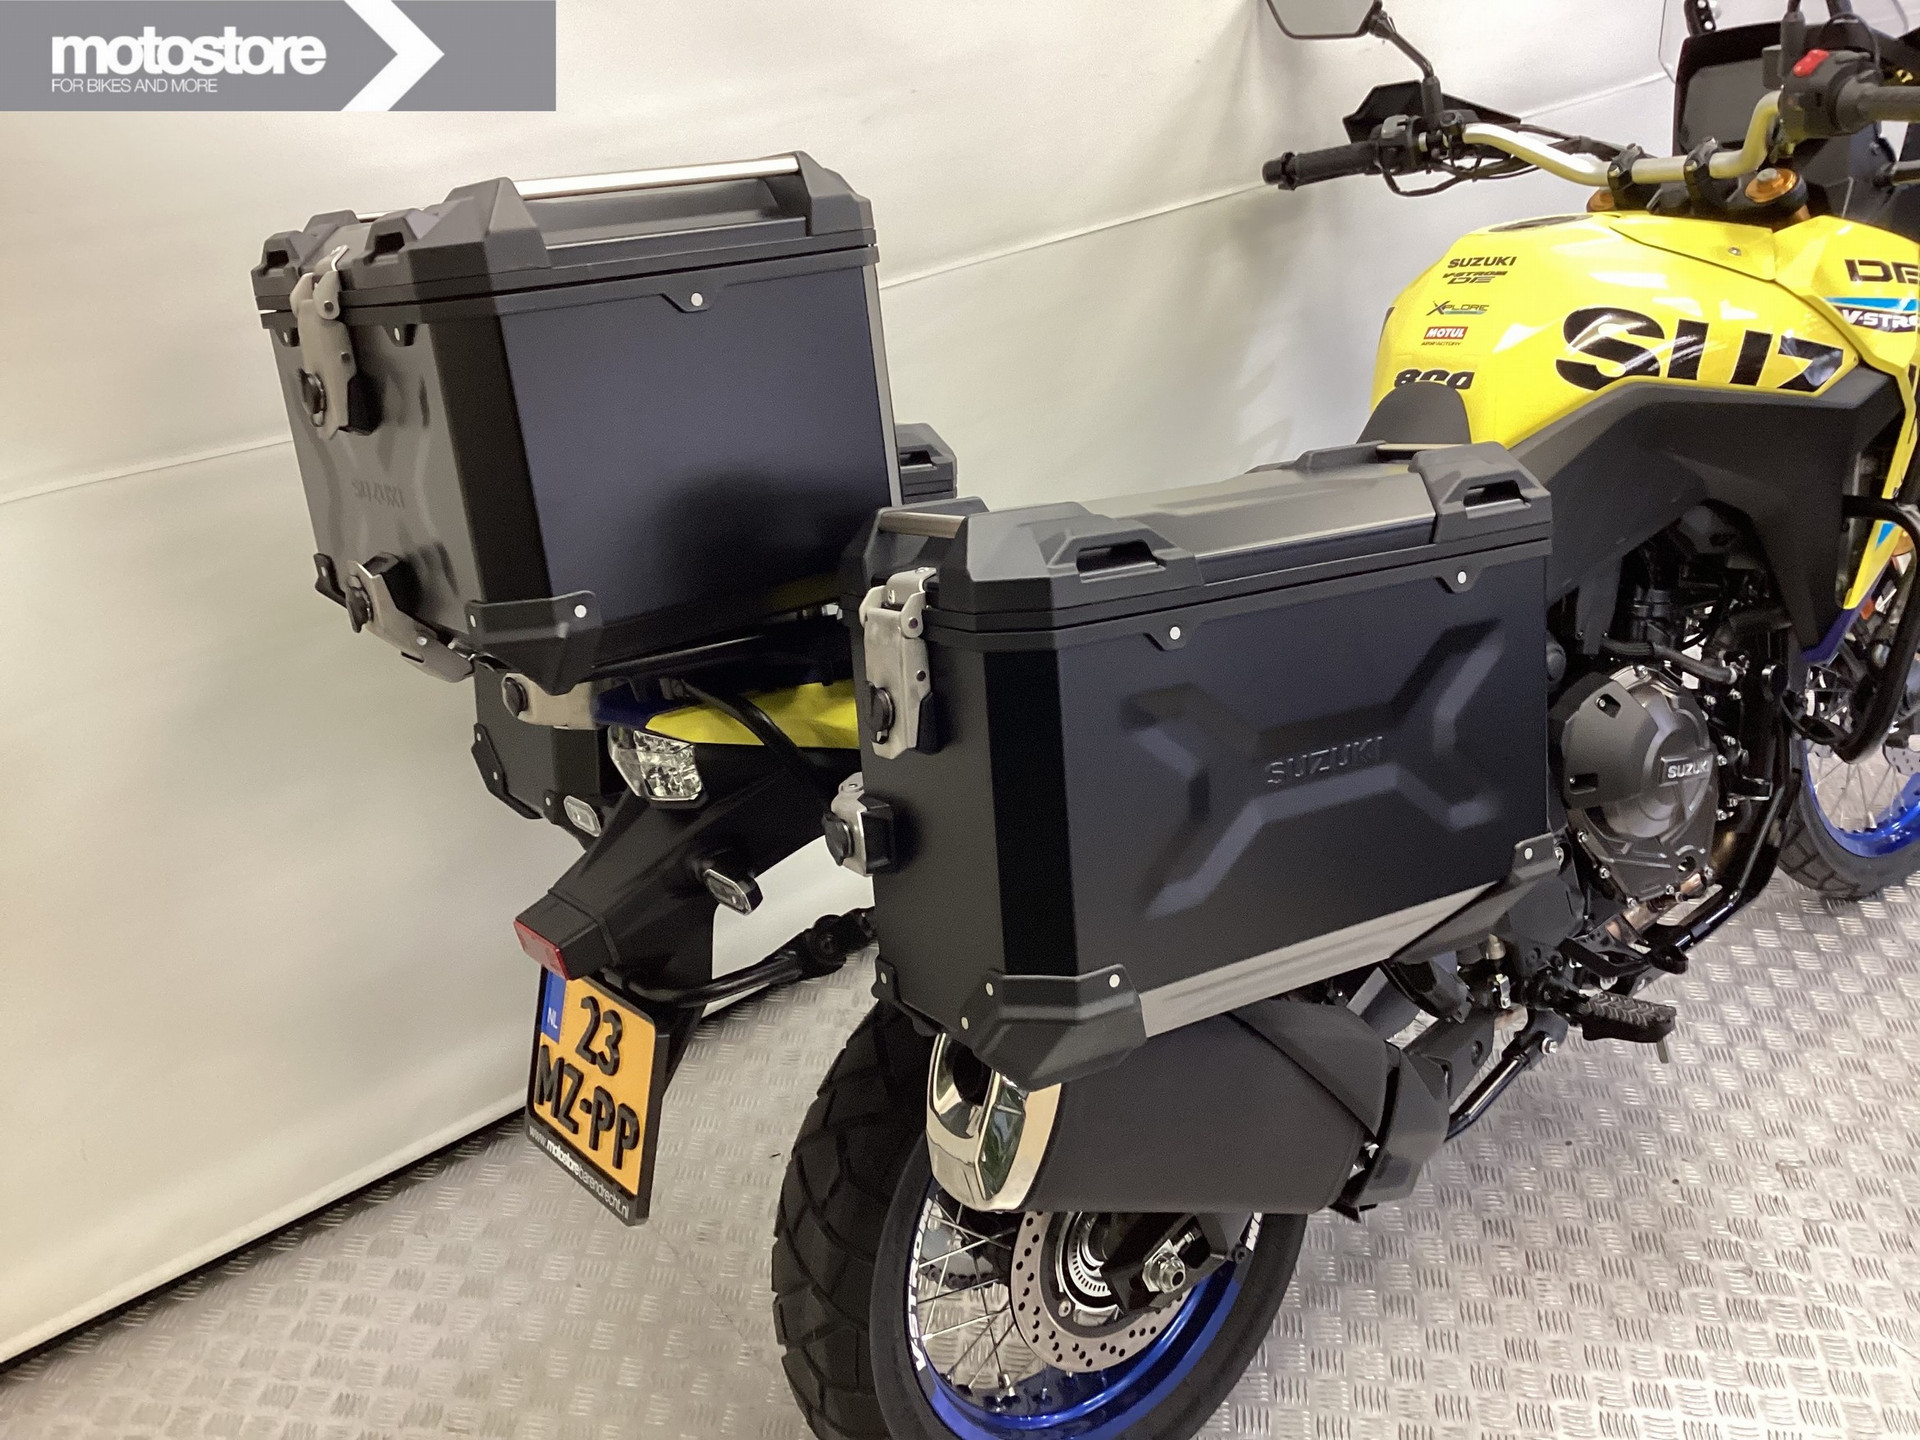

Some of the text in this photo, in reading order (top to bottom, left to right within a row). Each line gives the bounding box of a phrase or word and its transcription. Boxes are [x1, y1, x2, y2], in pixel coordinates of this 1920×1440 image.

[1447, 256, 1517, 268] SUZUKI
[1426, 328, 1465, 338] MOTUL
[1264, 736, 1383, 784] SUZUKI
[547, 1007, 558, 1029] NL
[575, 995, 623, 1077] 23
[534, 1045, 640, 1170] MZ-PP
